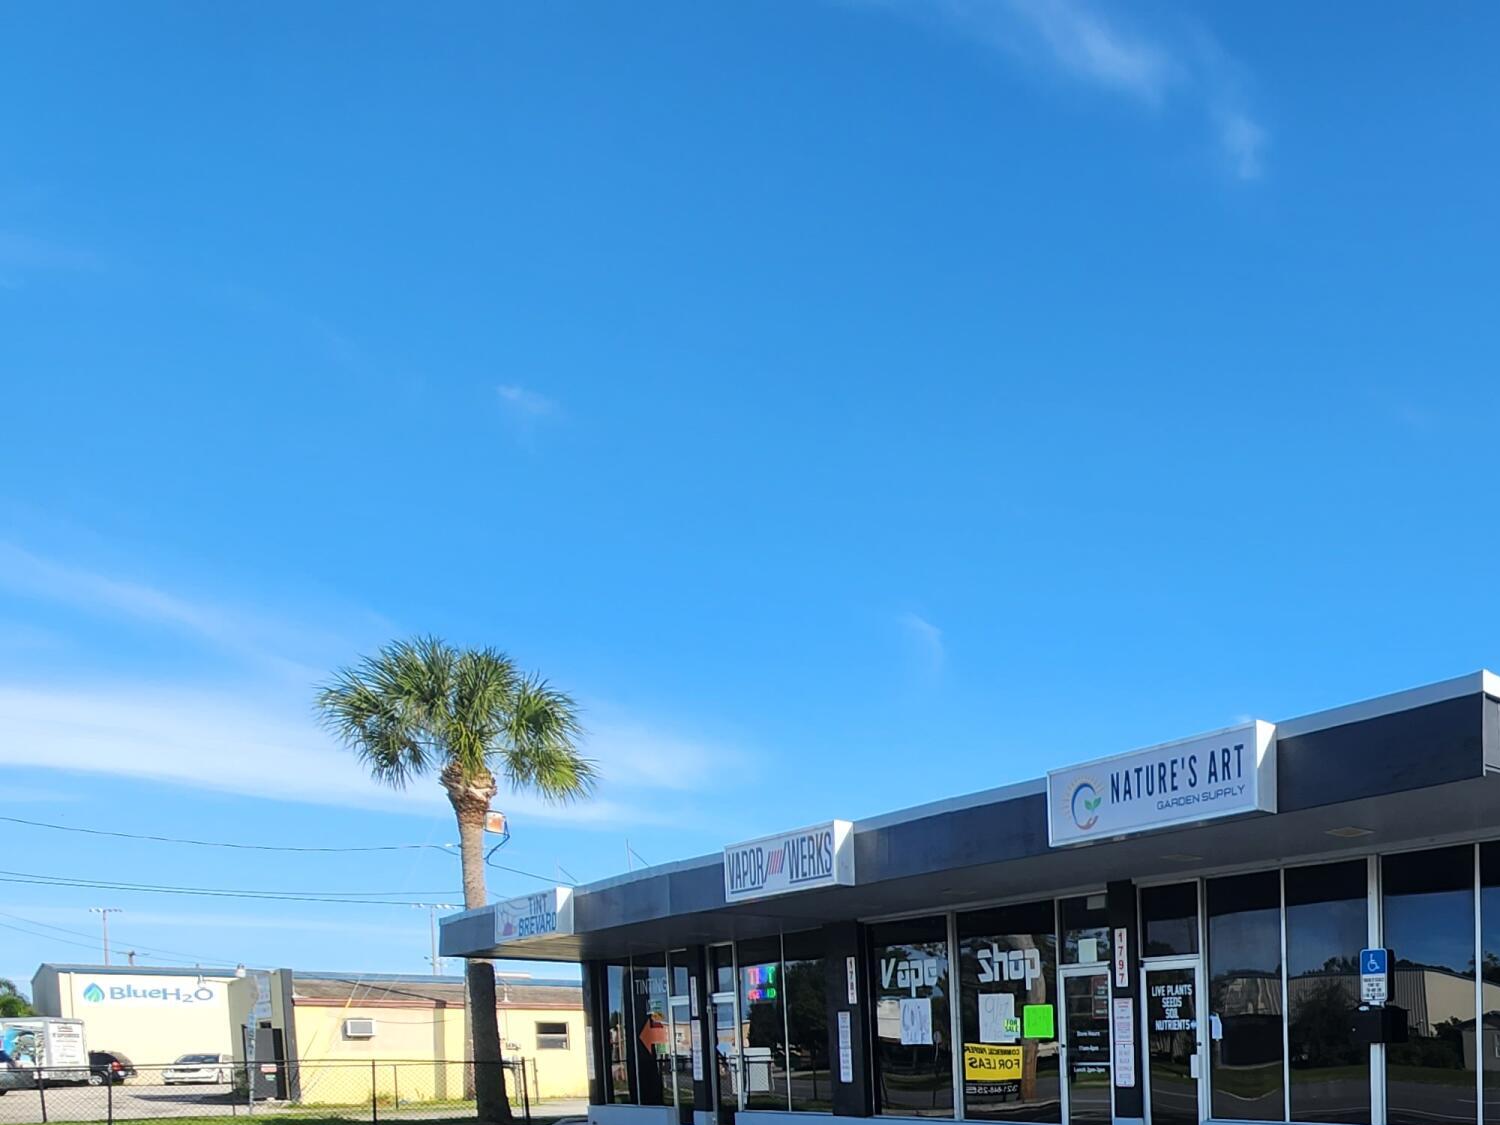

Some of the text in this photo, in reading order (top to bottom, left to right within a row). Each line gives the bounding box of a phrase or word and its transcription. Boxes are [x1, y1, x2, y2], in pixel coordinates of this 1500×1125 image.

[1110, 744, 1244, 804] NATURE'S ART
[1157, 784, 1246, 810] GARDEN SUPPLY
[728, 831, 833, 889] VAPOR WERKS
[527, 893, 548, 915] TINT
[518, 912, 557, 937] BREVARD
[1117, 931, 1125, 984] 1797
[109, 984, 214, 1002] BlueH2O
[1151, 984, 1193, 997] LIVE PLANTS
[1161, 997, 1182, 1008] SEEDS
[1165, 1008, 1180, 1019] SOIL
[1155, 1019, 1191, 1031] NUTRIENTS
